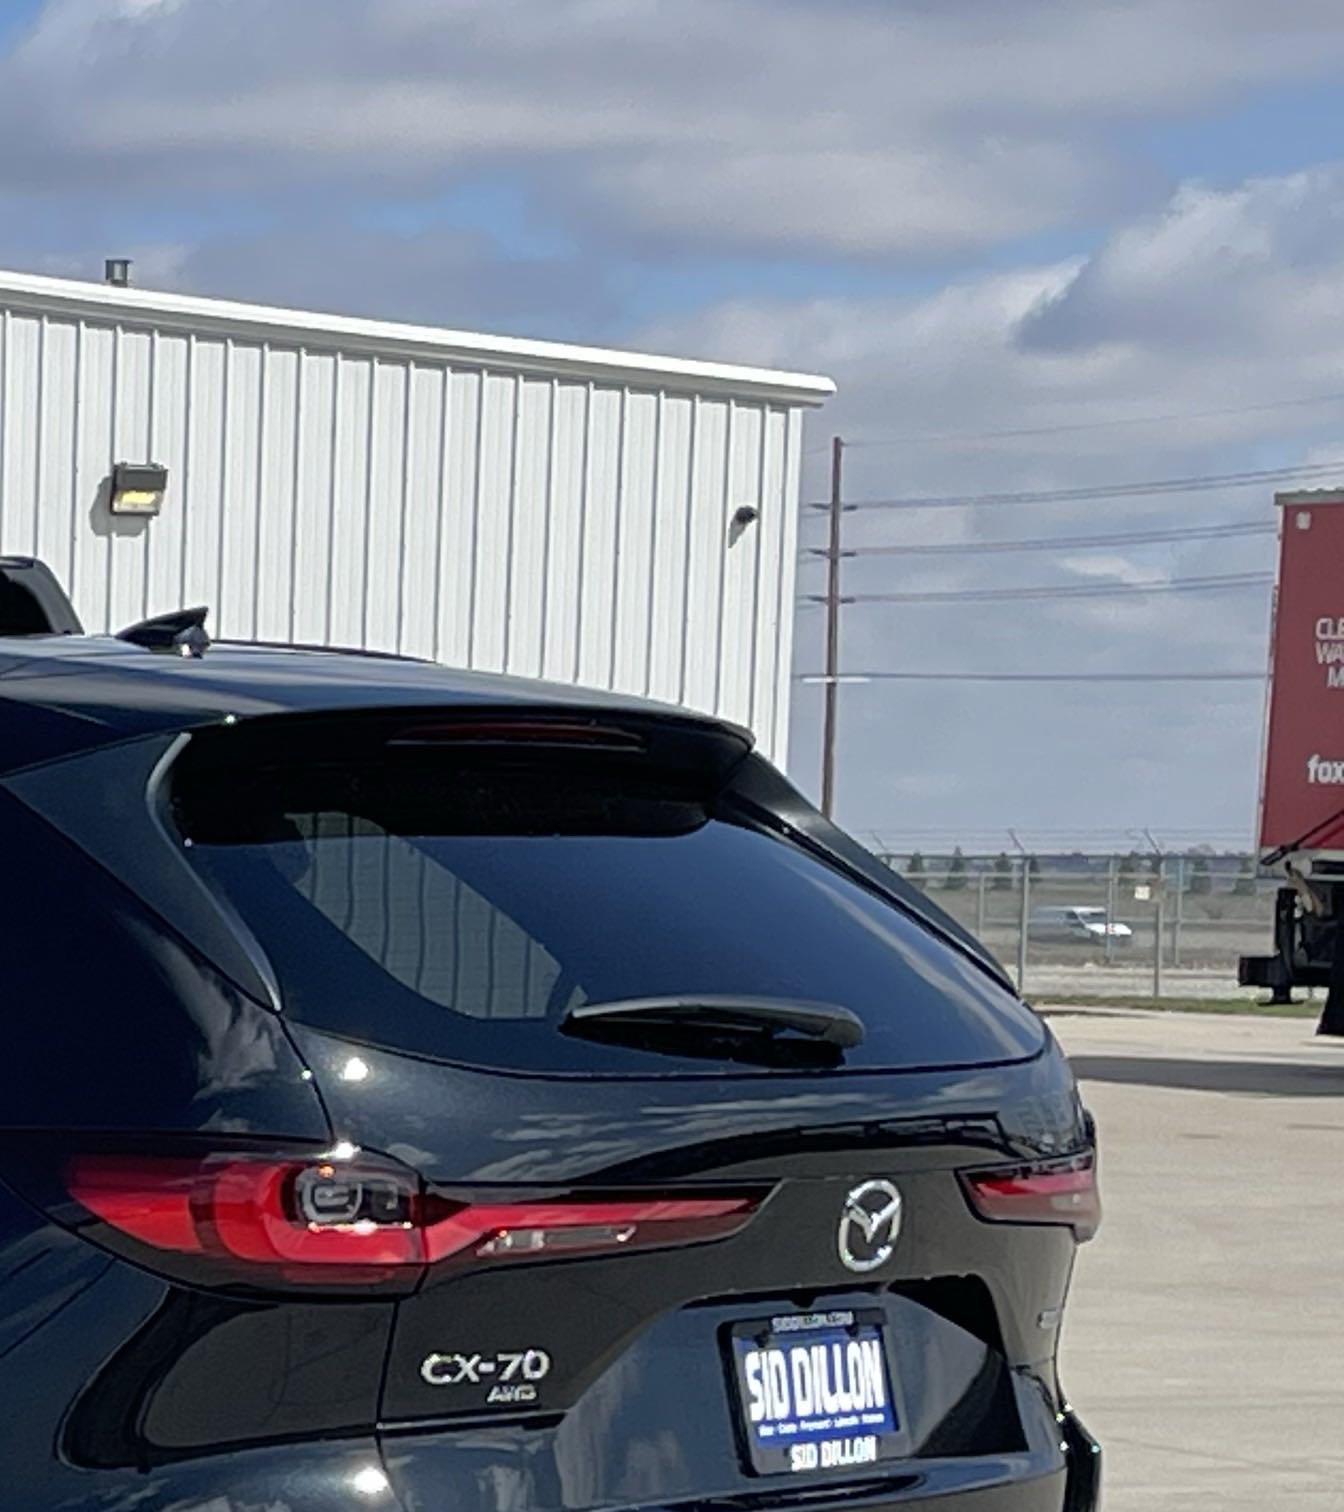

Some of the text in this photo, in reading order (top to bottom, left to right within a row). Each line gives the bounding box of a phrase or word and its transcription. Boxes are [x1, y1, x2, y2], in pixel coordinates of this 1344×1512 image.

[420, 1349, 550, 1385] CX-70
[745, 1340, 886, 1421] SID DILLON
[791, 1435, 877, 1471] SID DILLON
